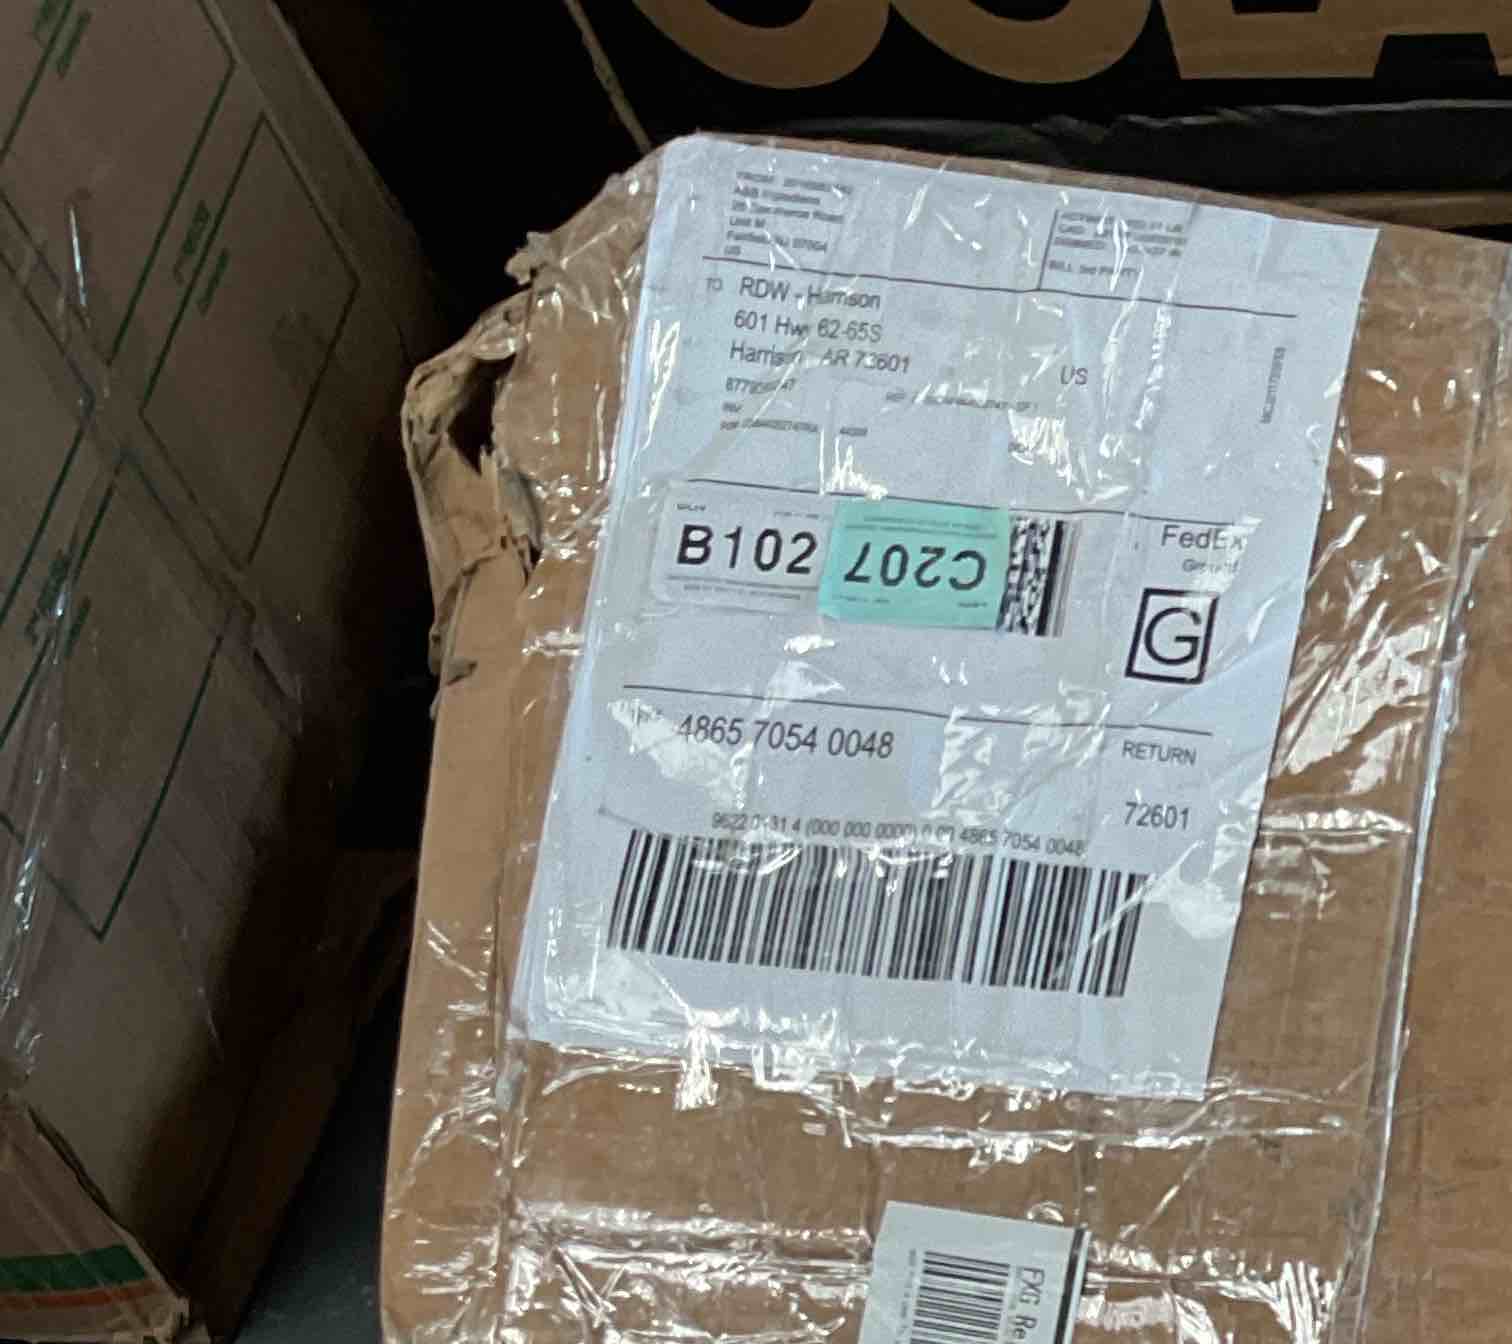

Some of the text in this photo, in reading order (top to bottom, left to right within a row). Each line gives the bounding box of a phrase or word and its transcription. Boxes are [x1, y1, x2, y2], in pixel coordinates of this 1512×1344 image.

[739, 276, 790, 301] RDW
[734, 309, 767, 333] 601
[817, 318, 882, 344] 62-65S
[821, 348, 847, 366] AR
[1060, 365, 1088, 386] US
[676, 524, 818, 575] B102
[1161, 524, 1243, 551] FedEx
[843, 541, 987, 591] C207
[1144, 607, 1202, 666] G
[677, 714, 894, 759] 4865 7054 0048
[1122, 741, 1197, 766] RETURN
[1123, 801, 1190, 830] 72601
[1001, 828, 1040, 850] 7054
[1018, 1266, 1046, 1306] FXG
